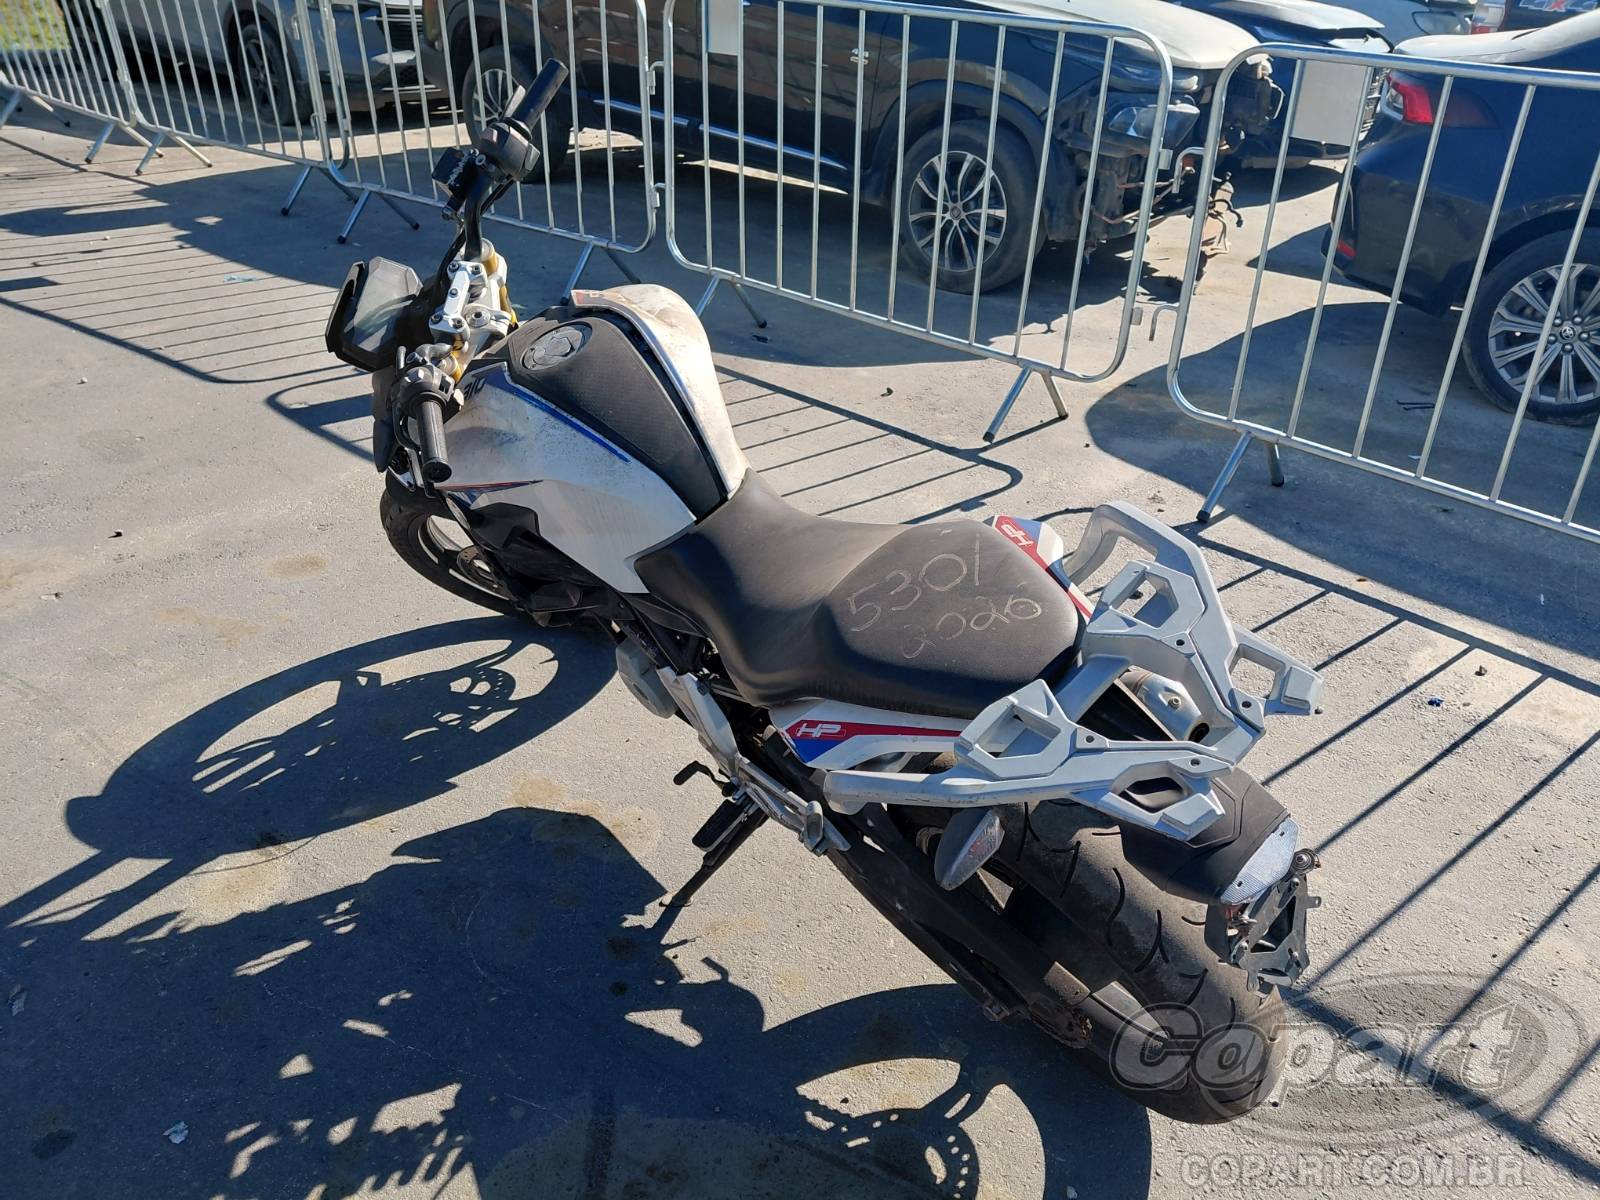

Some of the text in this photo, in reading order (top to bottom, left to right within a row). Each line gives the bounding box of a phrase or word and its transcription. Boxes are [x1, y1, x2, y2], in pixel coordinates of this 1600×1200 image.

[1001, 524, 1034, 546] HP
[848, 535, 981, 632] 5301
[796, 723, 841, 738] HP
